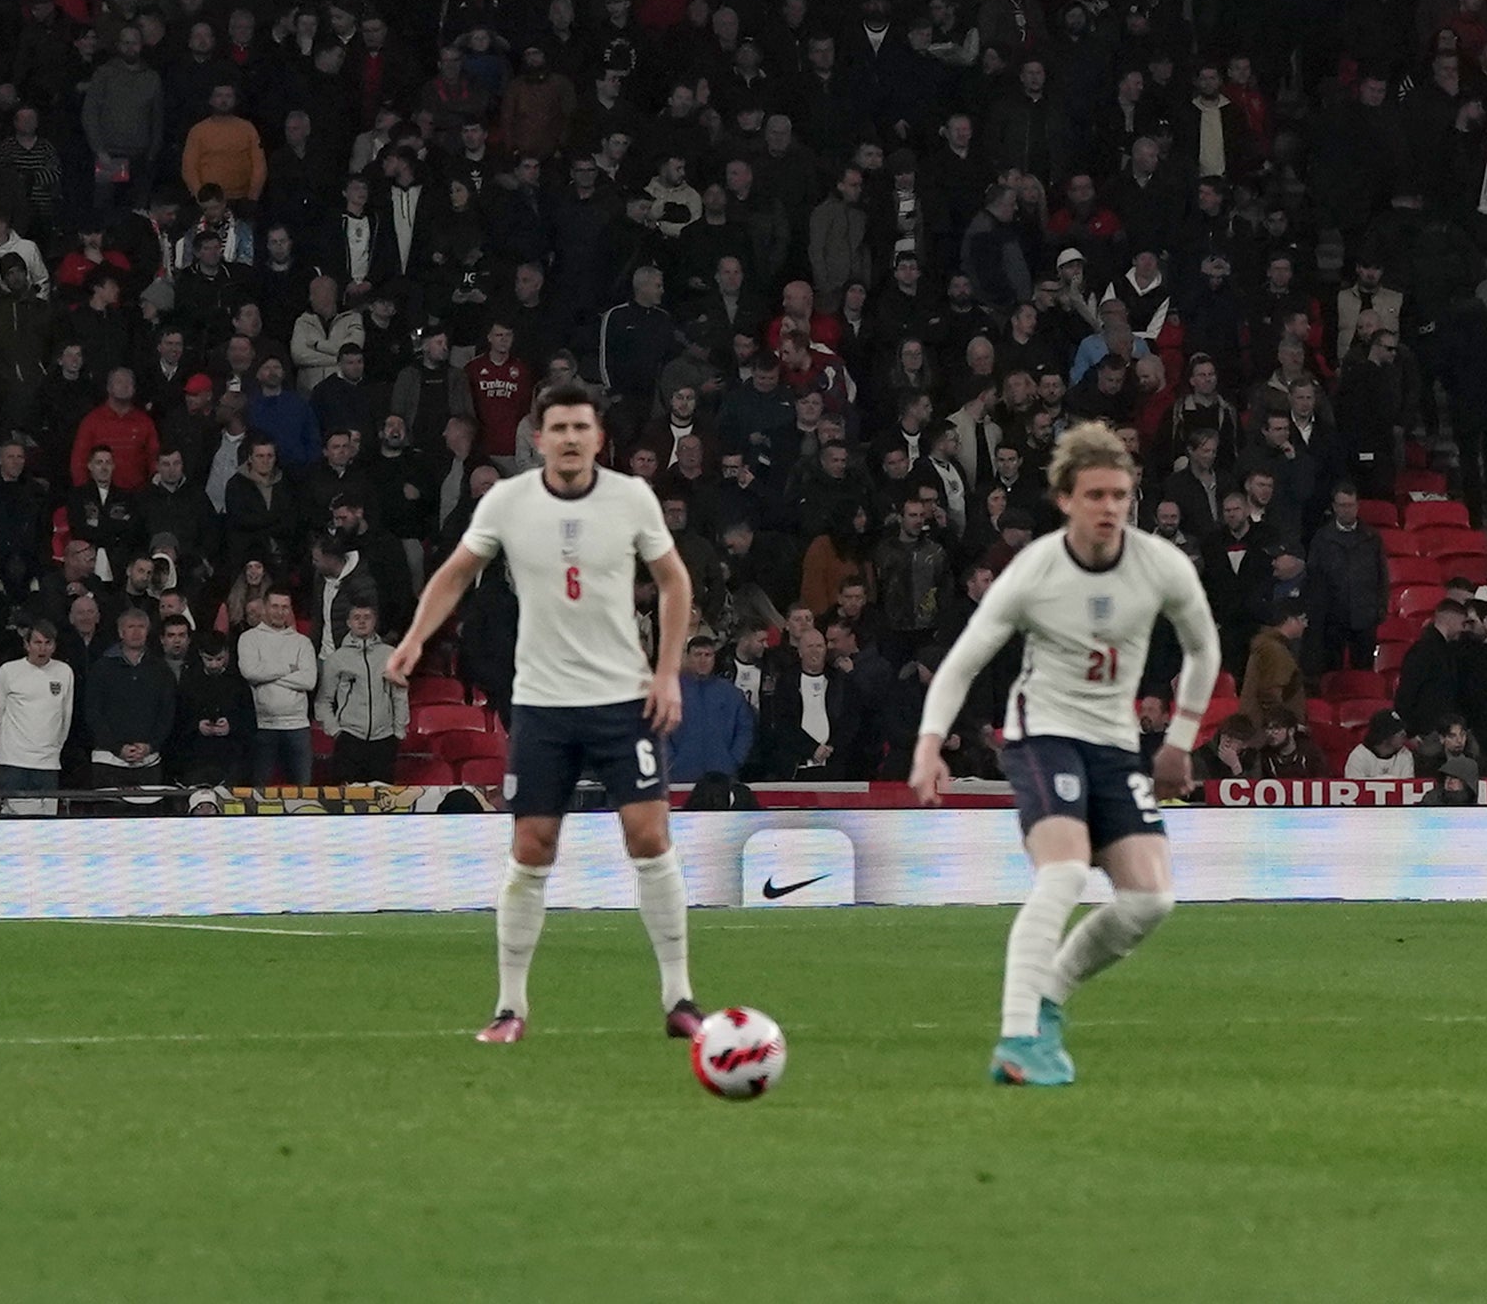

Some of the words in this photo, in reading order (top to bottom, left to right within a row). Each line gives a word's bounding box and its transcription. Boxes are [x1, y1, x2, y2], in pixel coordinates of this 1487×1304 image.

[565, 566, 581, 601] 6
[1086, 646, 1119, 681] 21
[636, 738, 657, 776] 6
[1126, 772, 1156, 810] 2
